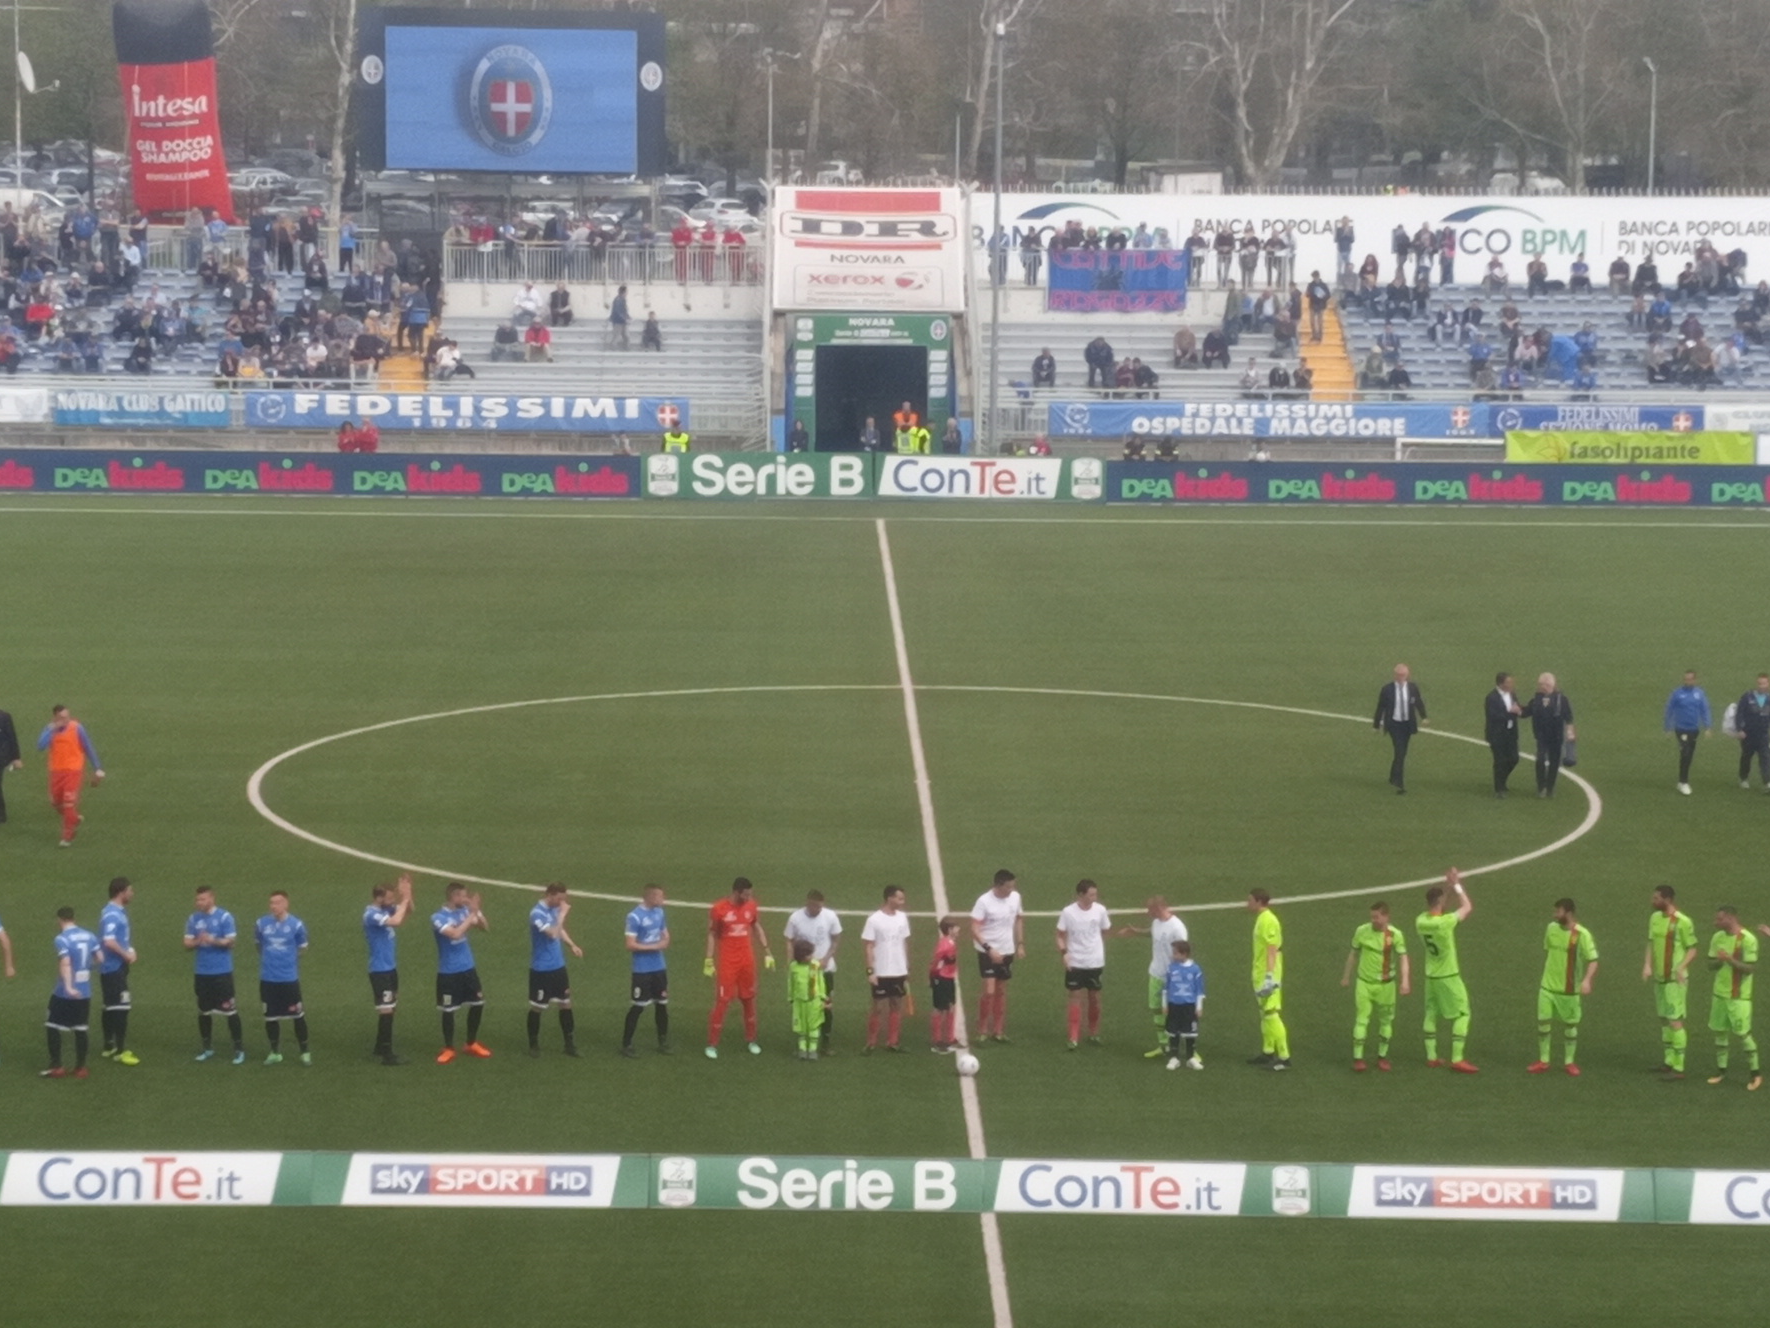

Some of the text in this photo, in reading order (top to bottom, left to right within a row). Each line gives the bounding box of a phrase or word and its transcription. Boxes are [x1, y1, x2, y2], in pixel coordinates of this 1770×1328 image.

[136, 133, 214, 152] GEL DOCCIA
[141, 148, 212, 164] SHAMPOO
[1262, 219, 1353, 235] POPOLA
[1618, 221, 1679, 236] BANCA
[1520, 229, 1588, 255] BPM
[1618, 240, 1635, 255] DI
[830, 254, 906, 265] NOVARA
[807, 273, 885, 285] xerox
[848, 317, 895, 327] NOVARA
[56, 393, 226, 413] NOVARA CLUB GATTICO
[294, 394, 639, 419] FEDELISSIMI
[1184, 403, 1354, 418] FEDELISSIMI
[1558, 406, 1640, 422] FEDELISSIMI
[1131, 418, 1407, 436] OSPEDALE MAGGIORE
[691, 454, 1047, 496] Serie B ConTe.it
[1423, 934, 1439, 957] 5
[76, 942, 90, 969] 7
[37, 1155, 242, 1201] ConTe.it
[375, 1164, 427, 1195] sky
[435, 1167, 541, 1192] SPORT
[550, 1171, 587, 1190] HD
[736, 1157, 894, 1210] Serie
[913, 1160, 957, 1210] B
[1019, 1163, 1222, 1212] ConTe.it
[1380, 1177, 1429, 1208] sky
[1438, 1180, 1545, 1205] SPORT
[1554, 1184, 1593, 1203] HD
